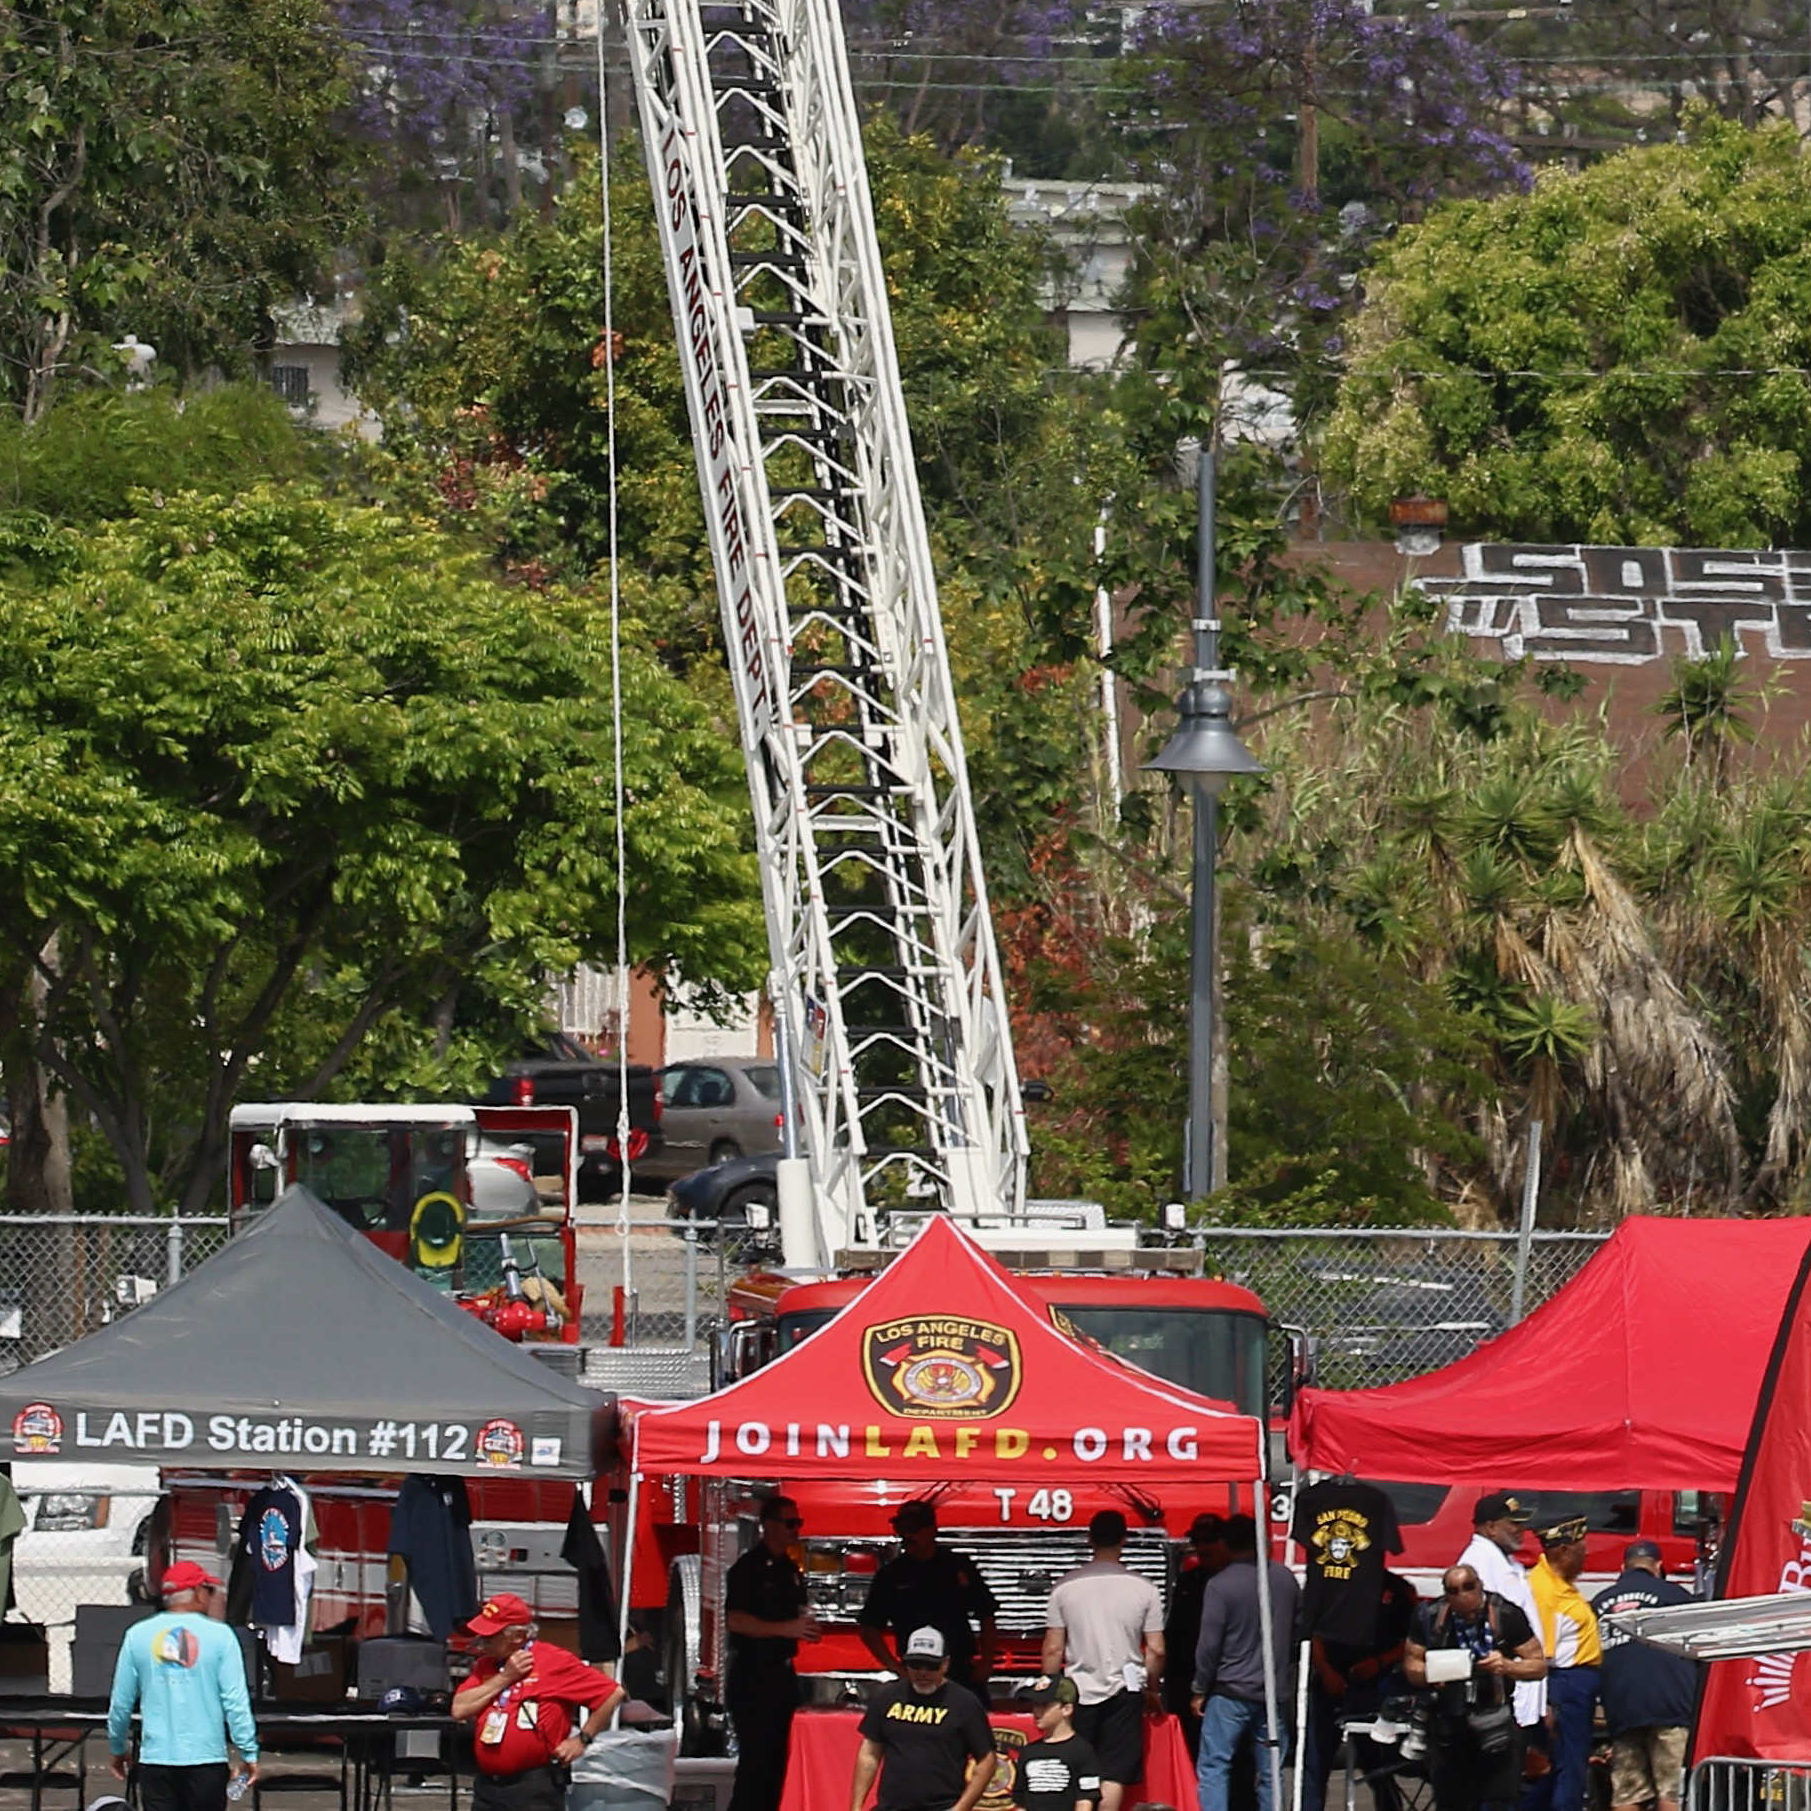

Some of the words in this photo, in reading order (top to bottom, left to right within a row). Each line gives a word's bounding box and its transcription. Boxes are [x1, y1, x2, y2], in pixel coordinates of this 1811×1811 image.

[876, 1324, 915, 1343] LOS
[917, 1321, 1007, 1346] ANGELES
[916, 1336, 965, 1351] FIRE
[902, 1407, 988, 1416] DEPARTMENT
[76, 1412, 195, 1449] LAFD
[207, 1415, 358, 1455] Station
[369, 1420, 468, 1461] #112
[700, 1420, 1199, 1464] JOINLAFD.ORG
[993, 1488, 1017, 1521] T
[1027, 1488, 1075, 1522] 48
[1316, 1510, 1336, 1526] SAN
[1336, 1508, 1369, 1528] PEDRO
[1323, 1565, 1351, 1580] FIRE
[886, 1702, 950, 1726] ARMY
